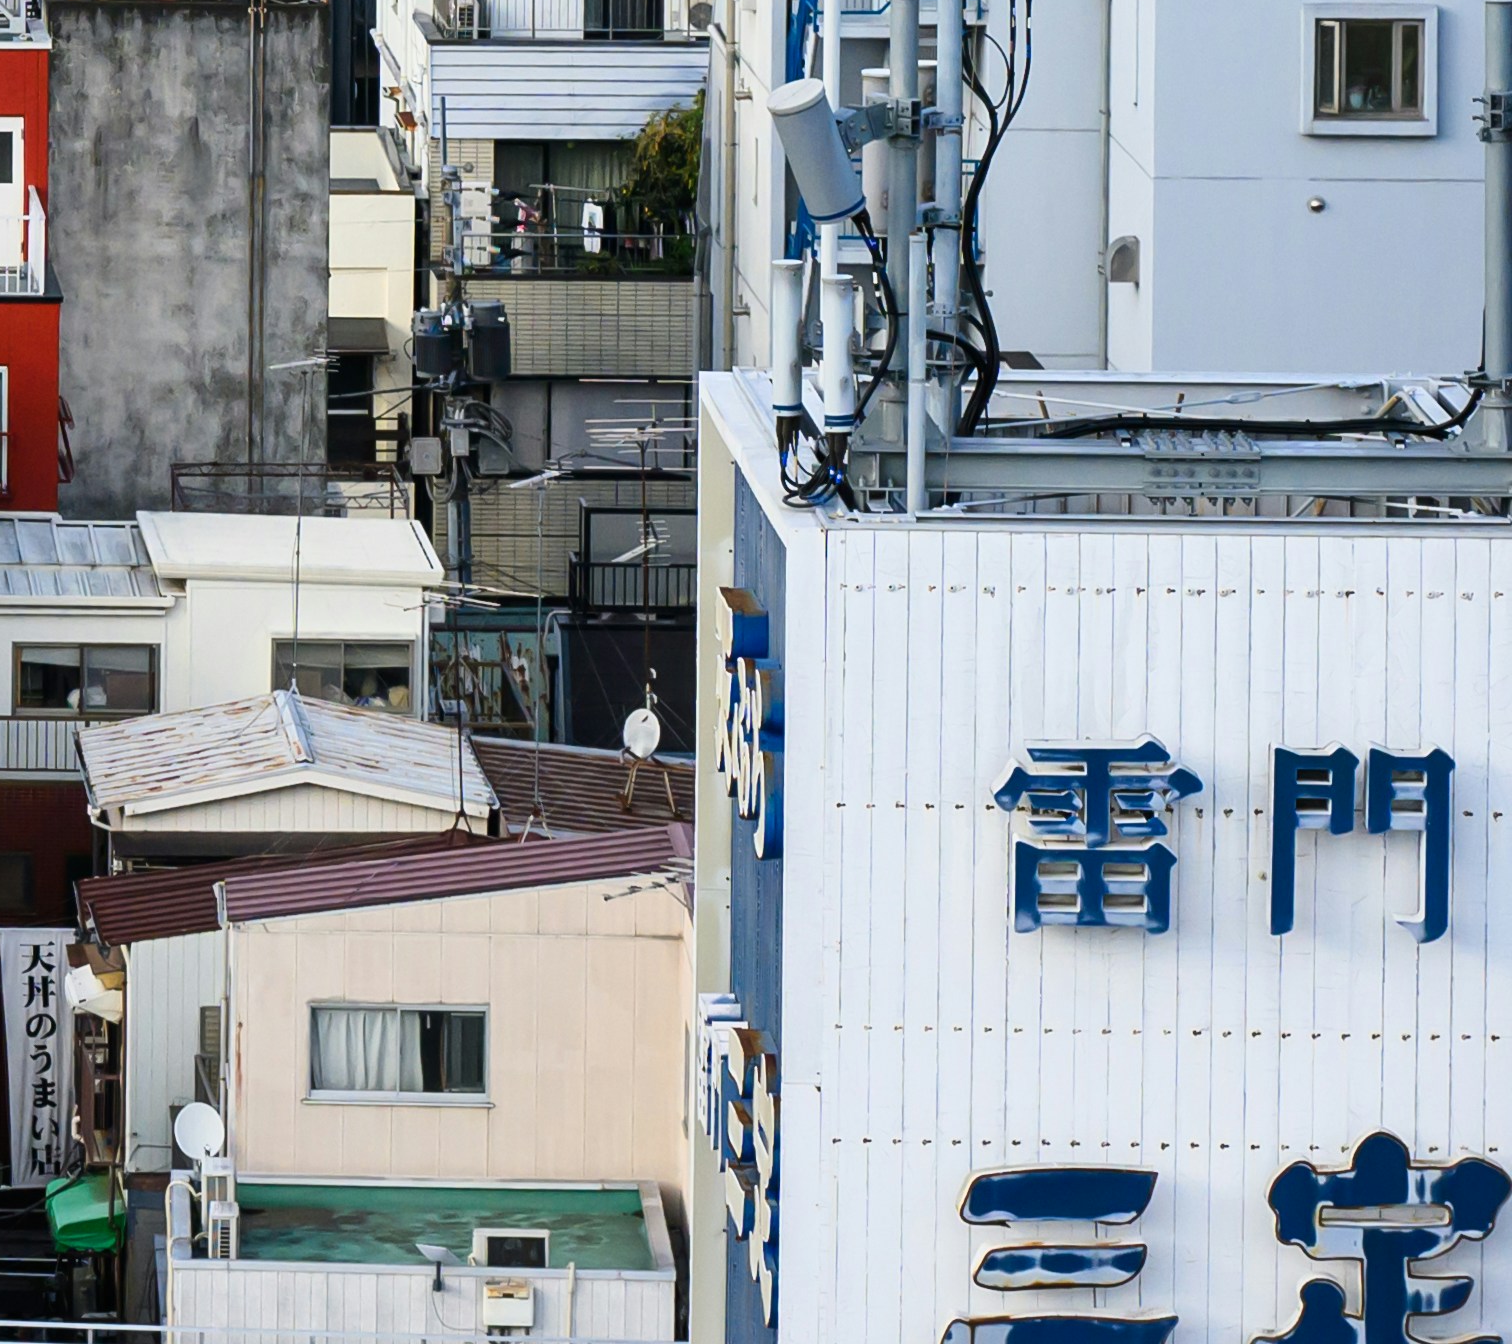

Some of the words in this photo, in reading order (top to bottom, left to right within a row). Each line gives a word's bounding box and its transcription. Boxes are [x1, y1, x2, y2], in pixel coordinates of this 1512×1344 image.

[990, 733, 1457, 944] 雷門
[20, 941, 62, 1178] 天丼のうまい店
